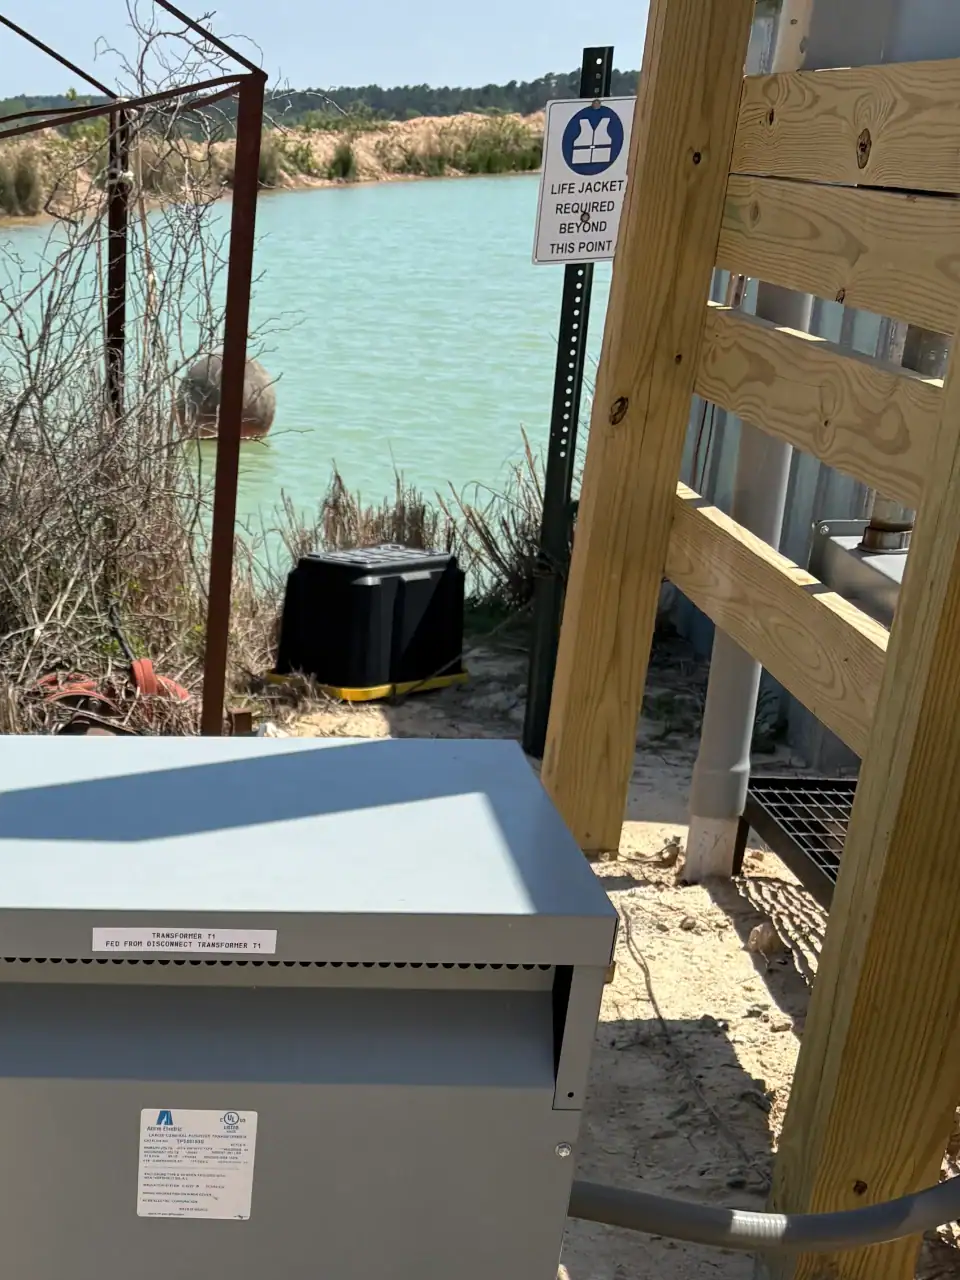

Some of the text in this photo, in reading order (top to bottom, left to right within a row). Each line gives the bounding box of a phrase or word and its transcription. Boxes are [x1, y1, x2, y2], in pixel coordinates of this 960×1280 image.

[550, 179, 624, 195] LIFE JACKET
[555, 200, 615, 215] REQUIRED
[558, 220, 607, 234] BEYOND
[549, 240, 613, 254] THIS POINT
[152, 932, 202, 940] TRANSFORMER
[105, 940, 120, 948] FED
[123, 940, 143, 948] FROM
[146, 940, 193, 949] DISCONNECT
[197, 941, 248, 949] TRANSFORMER
